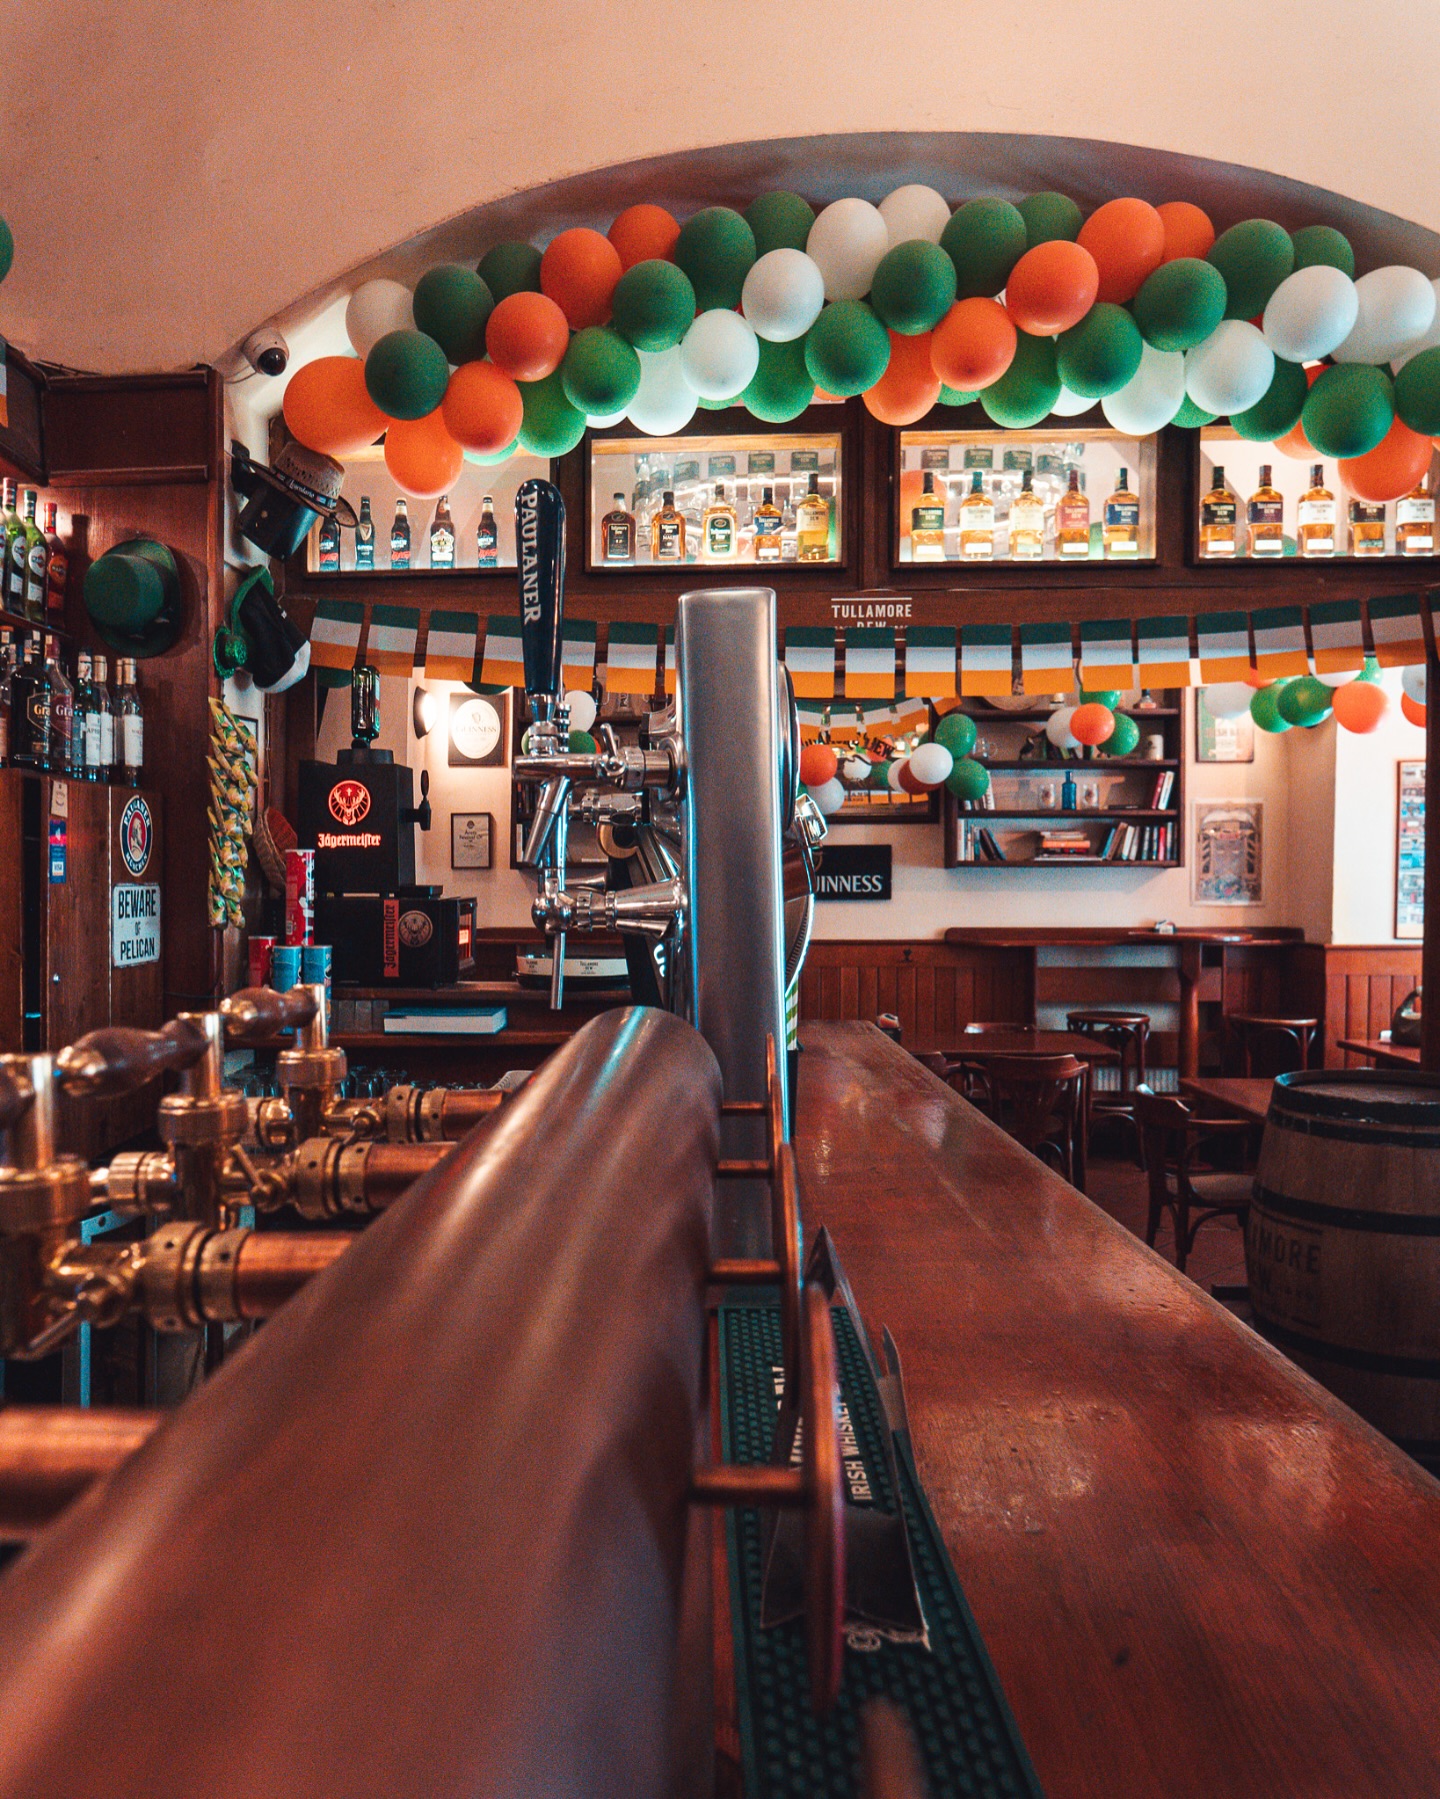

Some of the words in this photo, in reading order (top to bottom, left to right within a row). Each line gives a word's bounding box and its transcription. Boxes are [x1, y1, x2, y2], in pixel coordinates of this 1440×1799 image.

[521, 490, 542, 626] PAULANER
[831, 604, 912, 618] TULLAMORE
[118, 890, 156, 919] BEWARE
[134, 922, 141, 936] OF
[120, 937, 155, 961] PELICAN
[844, 1460, 873, 1500] IRISH
